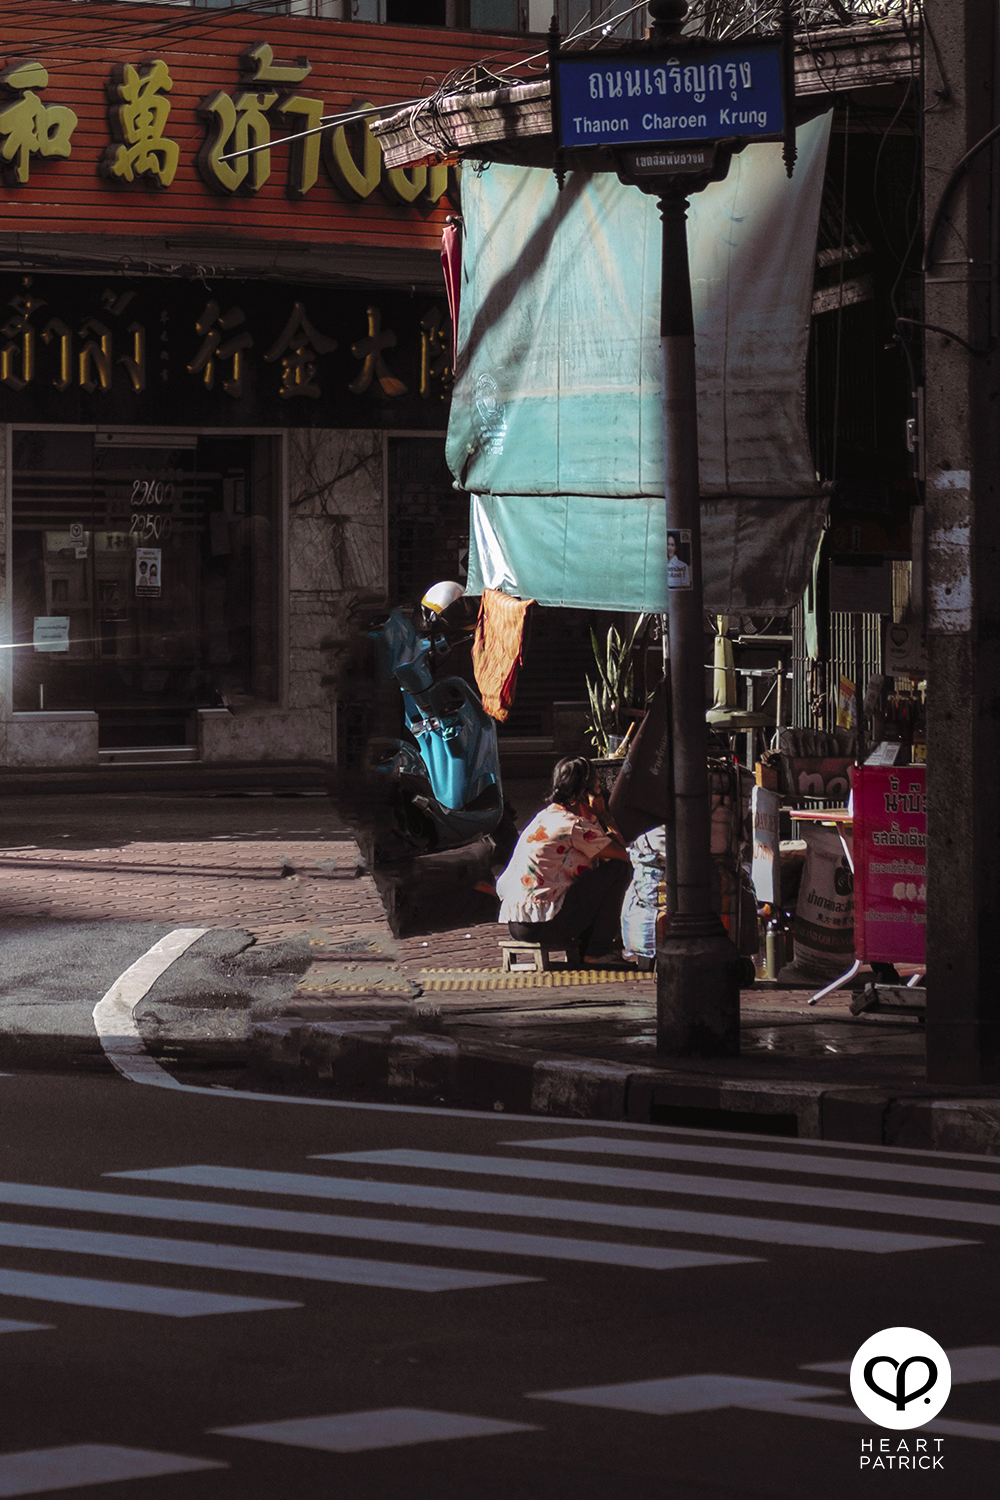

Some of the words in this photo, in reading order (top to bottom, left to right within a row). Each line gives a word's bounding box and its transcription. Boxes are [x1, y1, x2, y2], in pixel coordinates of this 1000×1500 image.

[588, 57, 752, 103] ถนนเจริญกรุง
[573, 116, 629, 133] Thanon
[642, 113, 707, 131] Charoen
[719, 108, 767, 128] Krung
